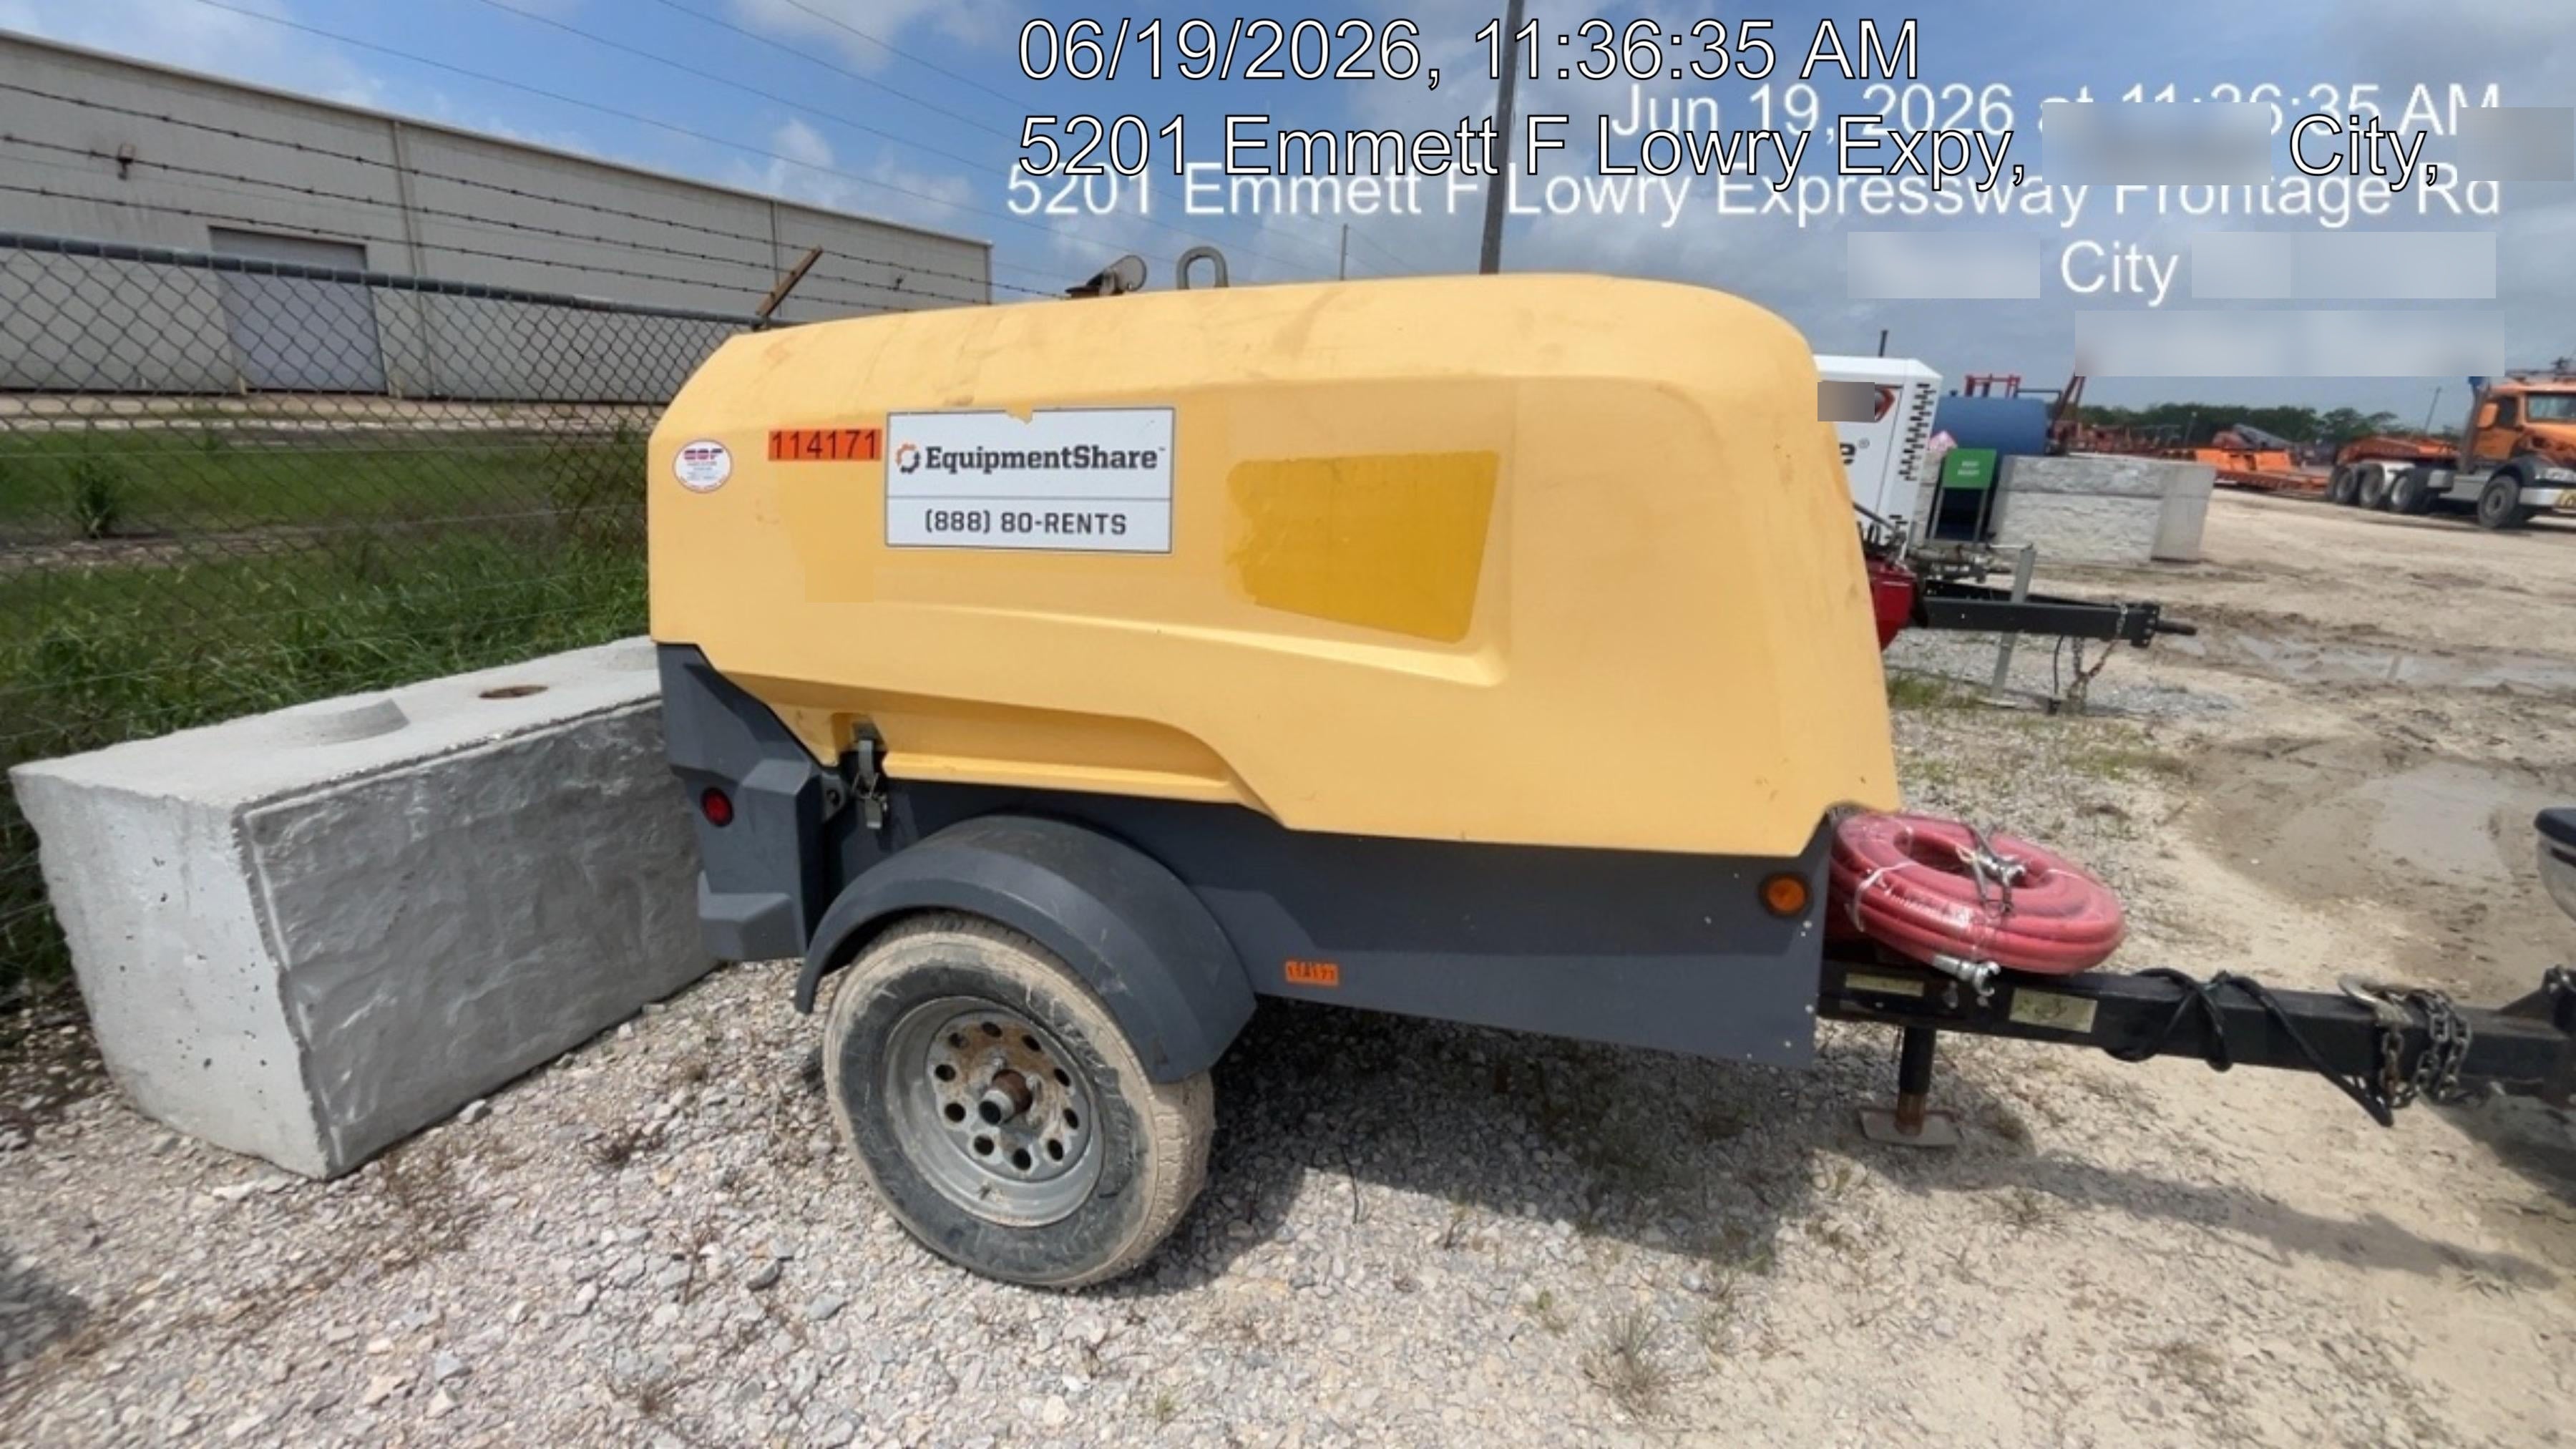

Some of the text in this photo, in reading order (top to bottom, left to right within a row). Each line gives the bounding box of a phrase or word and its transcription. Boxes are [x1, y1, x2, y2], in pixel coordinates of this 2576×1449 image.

[771, 429, 878, 459] 114171
[926, 444, 1158, 474] EquipmentShare
[925, 509, 1126, 535] (888) 80-RENTS
